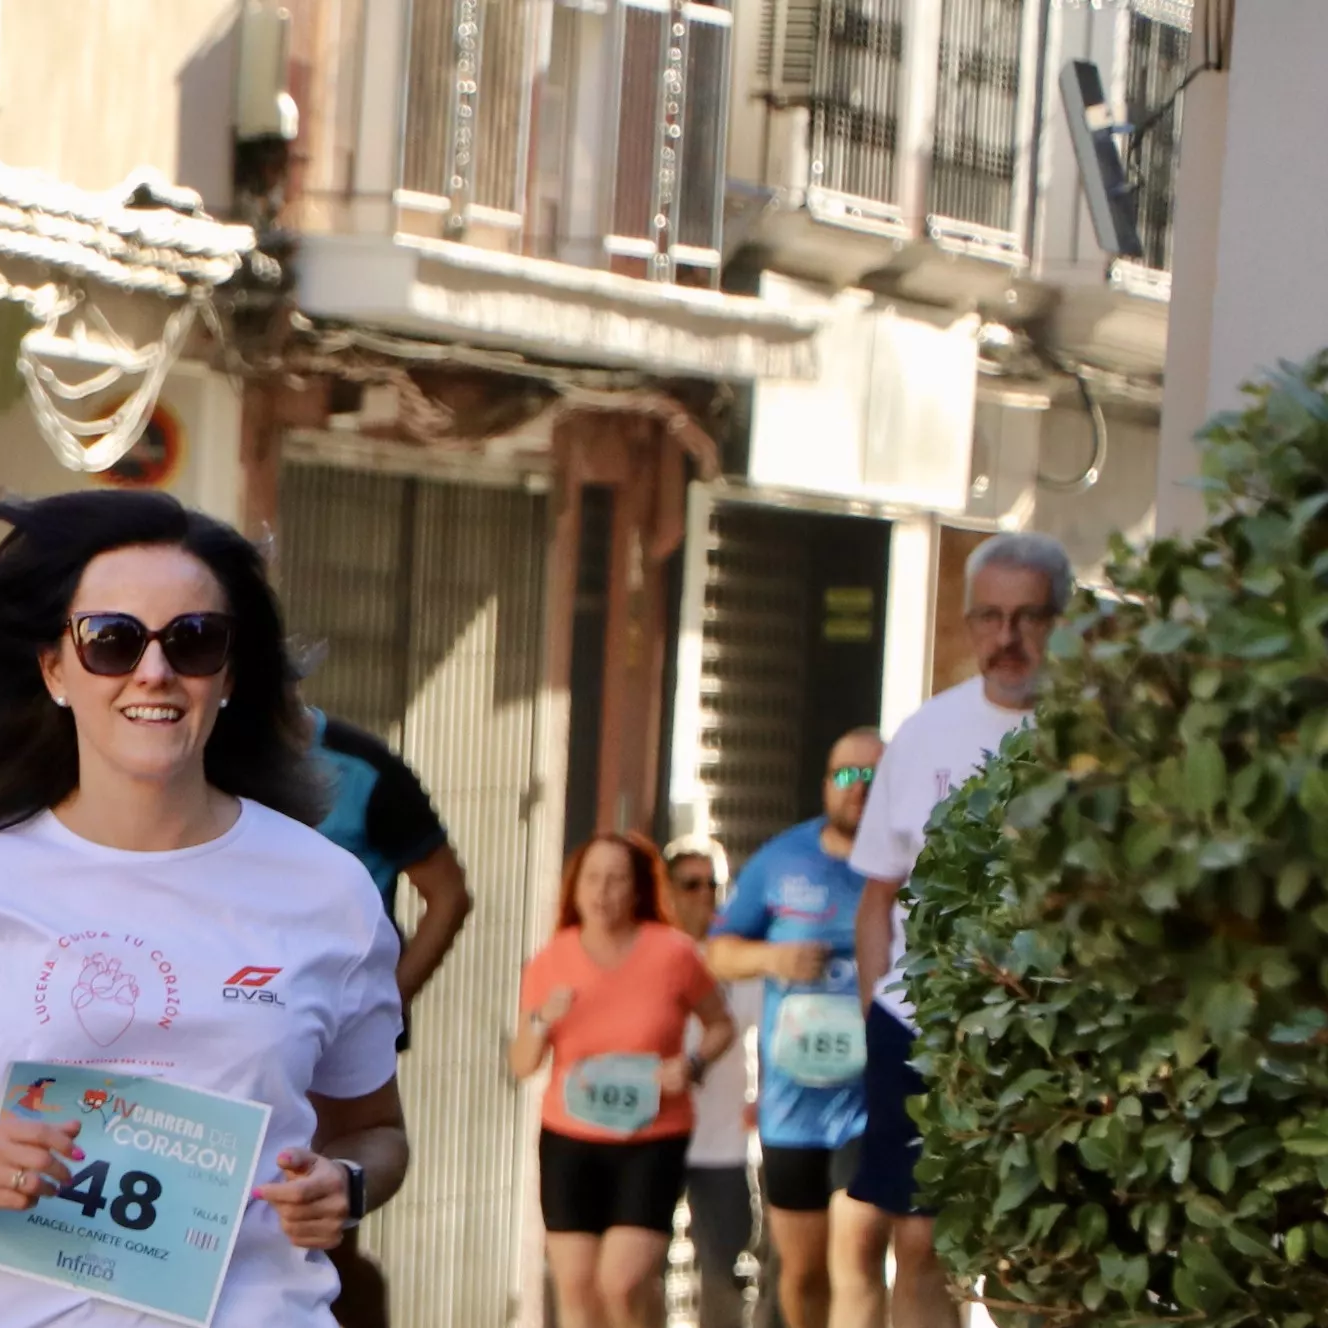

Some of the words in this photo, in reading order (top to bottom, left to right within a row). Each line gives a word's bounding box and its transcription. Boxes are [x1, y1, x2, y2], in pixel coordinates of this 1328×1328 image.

[58, 930, 111, 948] CUIDA
[124, 934, 145, 947] TU
[113, 1097, 137, 1118] IV
[133, 1105, 205, 1140] CARRERA
[56, 1159, 163, 1231] 48
[55, 1250, 115, 1281] Infrico
